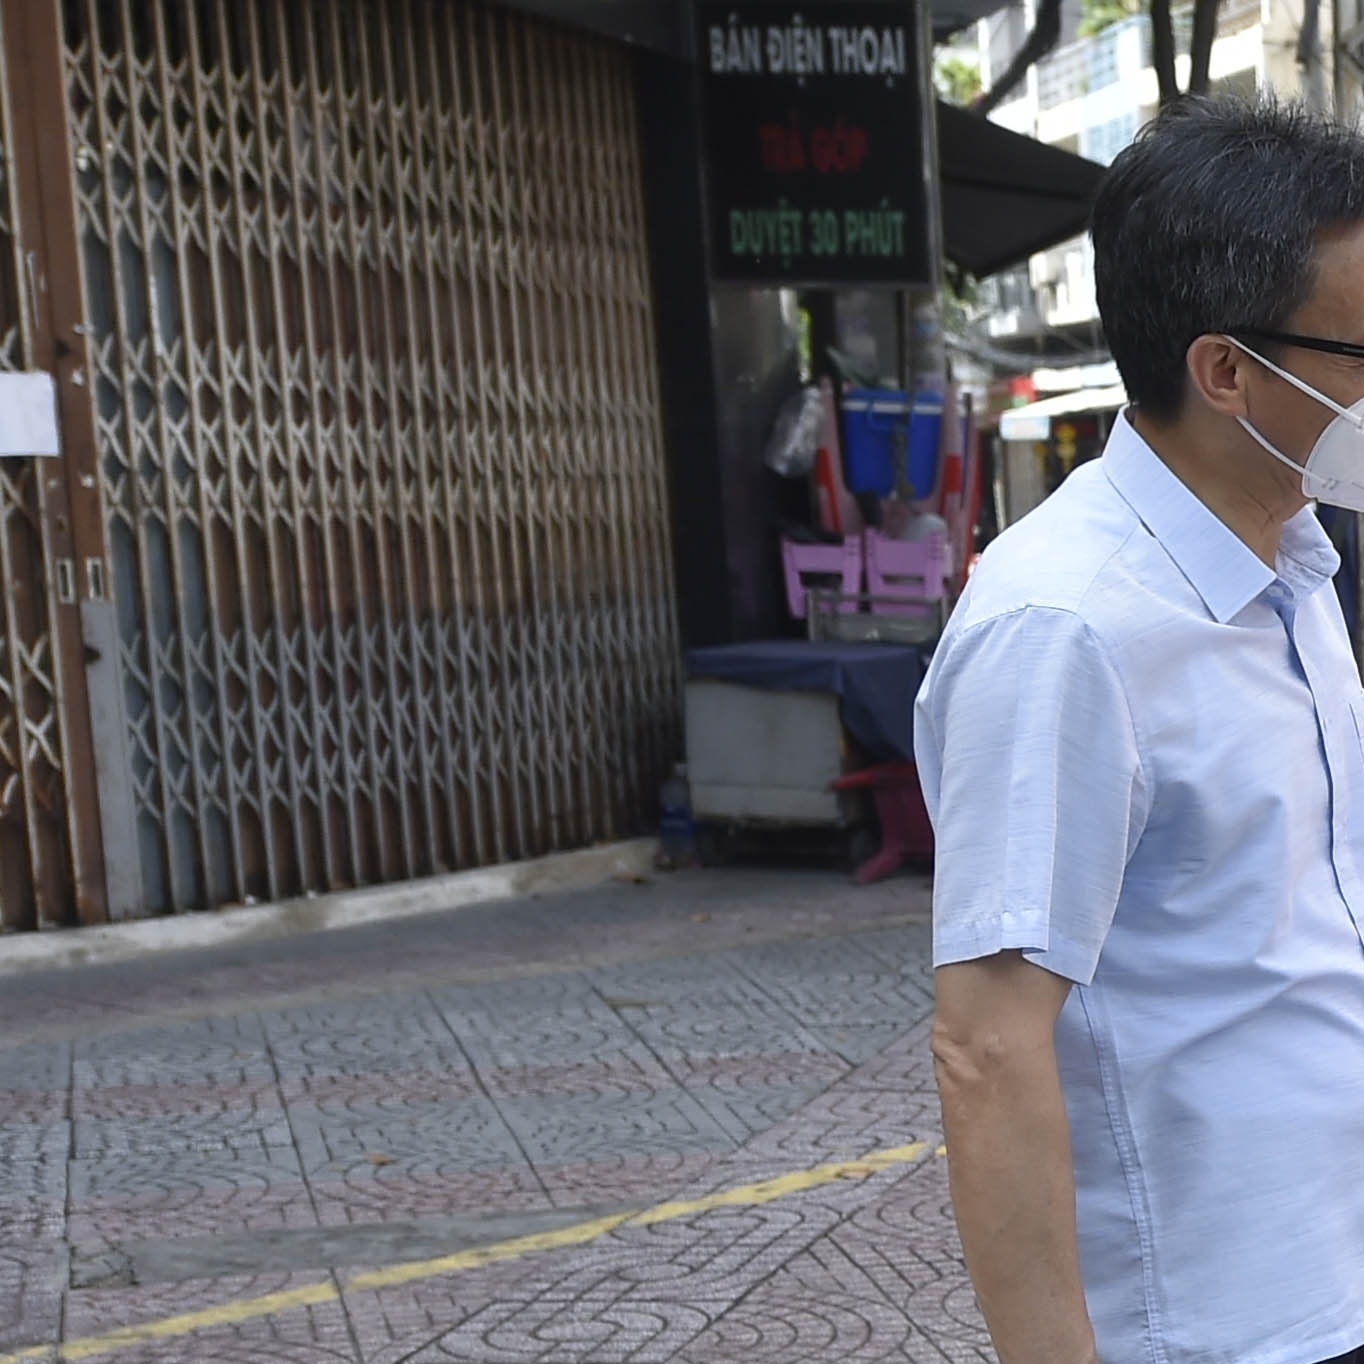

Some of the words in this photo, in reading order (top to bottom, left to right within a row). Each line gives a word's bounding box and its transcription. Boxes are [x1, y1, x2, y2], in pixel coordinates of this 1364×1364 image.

[709, 12, 762, 73] BÁN
[766, 13, 825, 86] ĐIỆN
[828, 26, 907, 87] THOẠI
[729, 198, 801, 269] DUYỆT
[808, 209, 839, 257] 30
[844, 199, 906, 257] PHÚT
